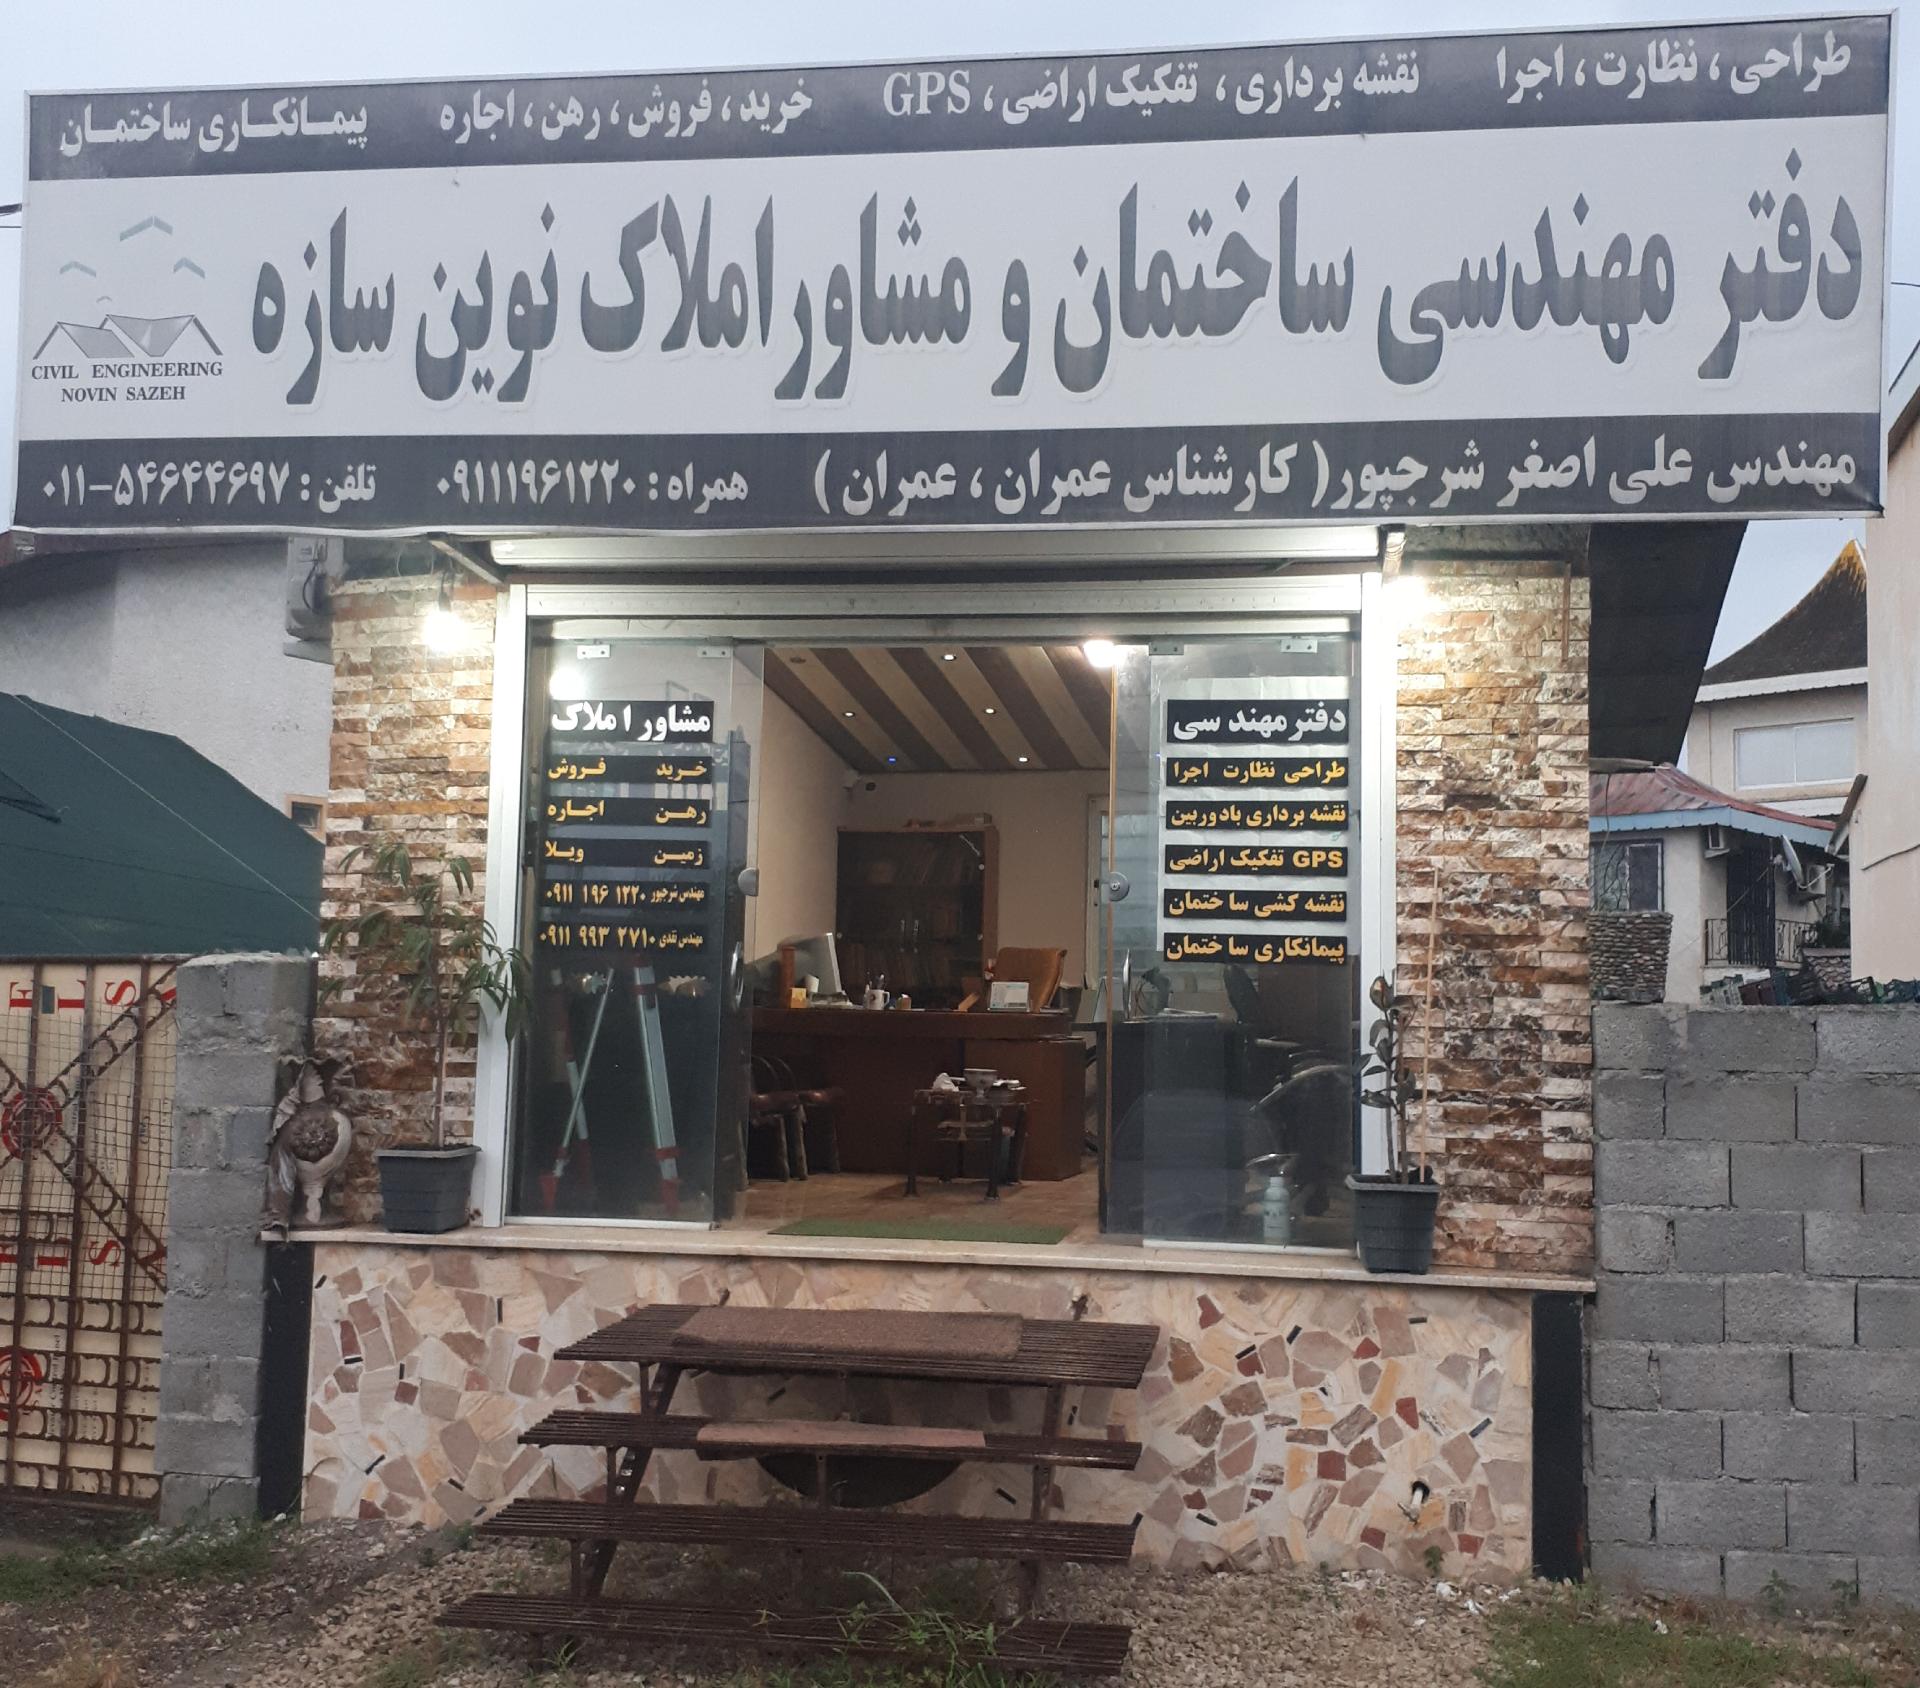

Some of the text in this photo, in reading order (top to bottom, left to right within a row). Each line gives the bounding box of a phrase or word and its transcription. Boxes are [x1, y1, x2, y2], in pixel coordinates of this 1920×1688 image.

[1105, 62, 1199, 115] تفکیک
[1353, 50, 1420, 94] نقشه
[1497, 43, 1564, 103] اجرا
[883, 70, 970, 115] GPS
[59, 100, 191, 157] ساختمان
[440, 88, 515, 144] اجاره
[252, 148, 1863, 405] دفتر مهندسی ساختمان و مشاور املاک نوین سازه
[31, 361, 224, 380] CIVIL ENGINEERING
[61, 386, 186, 402] NOVIN SAZEH
[1496, 436, 1597, 508] اصغر
[1608, 435, 1693, 503] علی
[1706, 441, 1857, 503] مهندس
[637, 704, 711, 741] مشاور
[1288, 701, 1346, 741] دفتر
[548, 757, 707, 781] خرید فروش
[1174, 761, 1345, 784] طراحی نظارت اجرا
[547, 799, 707, 824] رهن اجاره
[1310, 804, 1346, 822] نقشه
[545, 840, 703, 866] زمین ویلا
[1169, 848, 1343, 872] GPS تفکیک اراضی
[1254, 893, 1299, 918] کشی
[1304, 894, 1345, 913] نقشه
[1254, 936, 1345, 964] پیمانکاری
